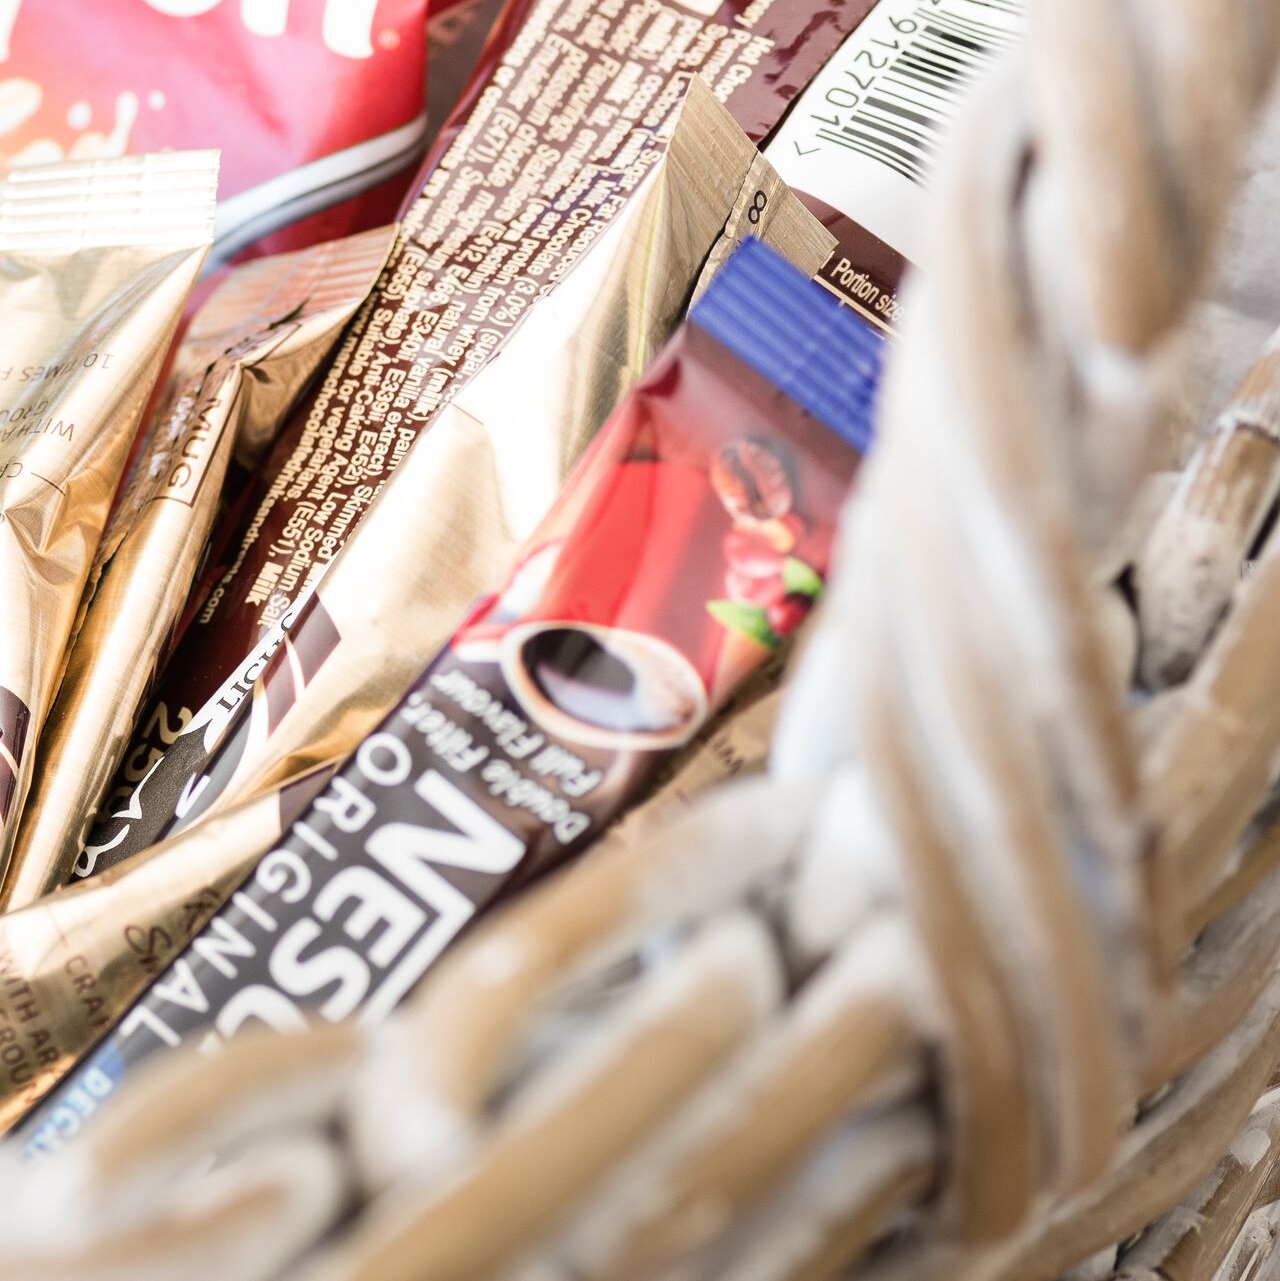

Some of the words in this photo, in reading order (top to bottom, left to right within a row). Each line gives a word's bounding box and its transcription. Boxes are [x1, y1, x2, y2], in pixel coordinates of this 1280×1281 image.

[811, 15, 918, 135] 912701
[415, 159, 482, 254] Sweetener
[529, 206, 566, 248] and
[492, 232, 542, 294] protein
[525, 197, 592, 286] Chocolate
[377, 242, 429, 312] (E955).
[464, 279, 505, 329] from
[830, 257, 881, 305] Portion
[343, 305, 395, 380] Suitable
[421, 294, 468, 358] natural
[437, 316, 478, 368] whey
[332, 375, 359, 407] for
[390, 352, 437, 415] vanilla
[400, 361, 454, 433] (milk),
[16, 410, 75, 447] WITH
[166, 391, 221, 495] MUG
[278, 401, 351, 509] vegetarians.
[356, 408, 410, 484] extract),
[304, 448, 349, 505] Agent
[311, 488, 346, 531] Low
[265, 494, 318, 564] (E551),
[275, 522, 326, 590] Sodium
[313, 480, 373, 564] Skimmed
[242, 557, 285, 611] Milk
[253, 590, 291, 633] Salt
[482, 764, 593, 846] Double
[539, 745, 604, 800] Full
[120, 733, 411, 1049] ORIGINAL
[202, 769, 526, 1054] NESC
